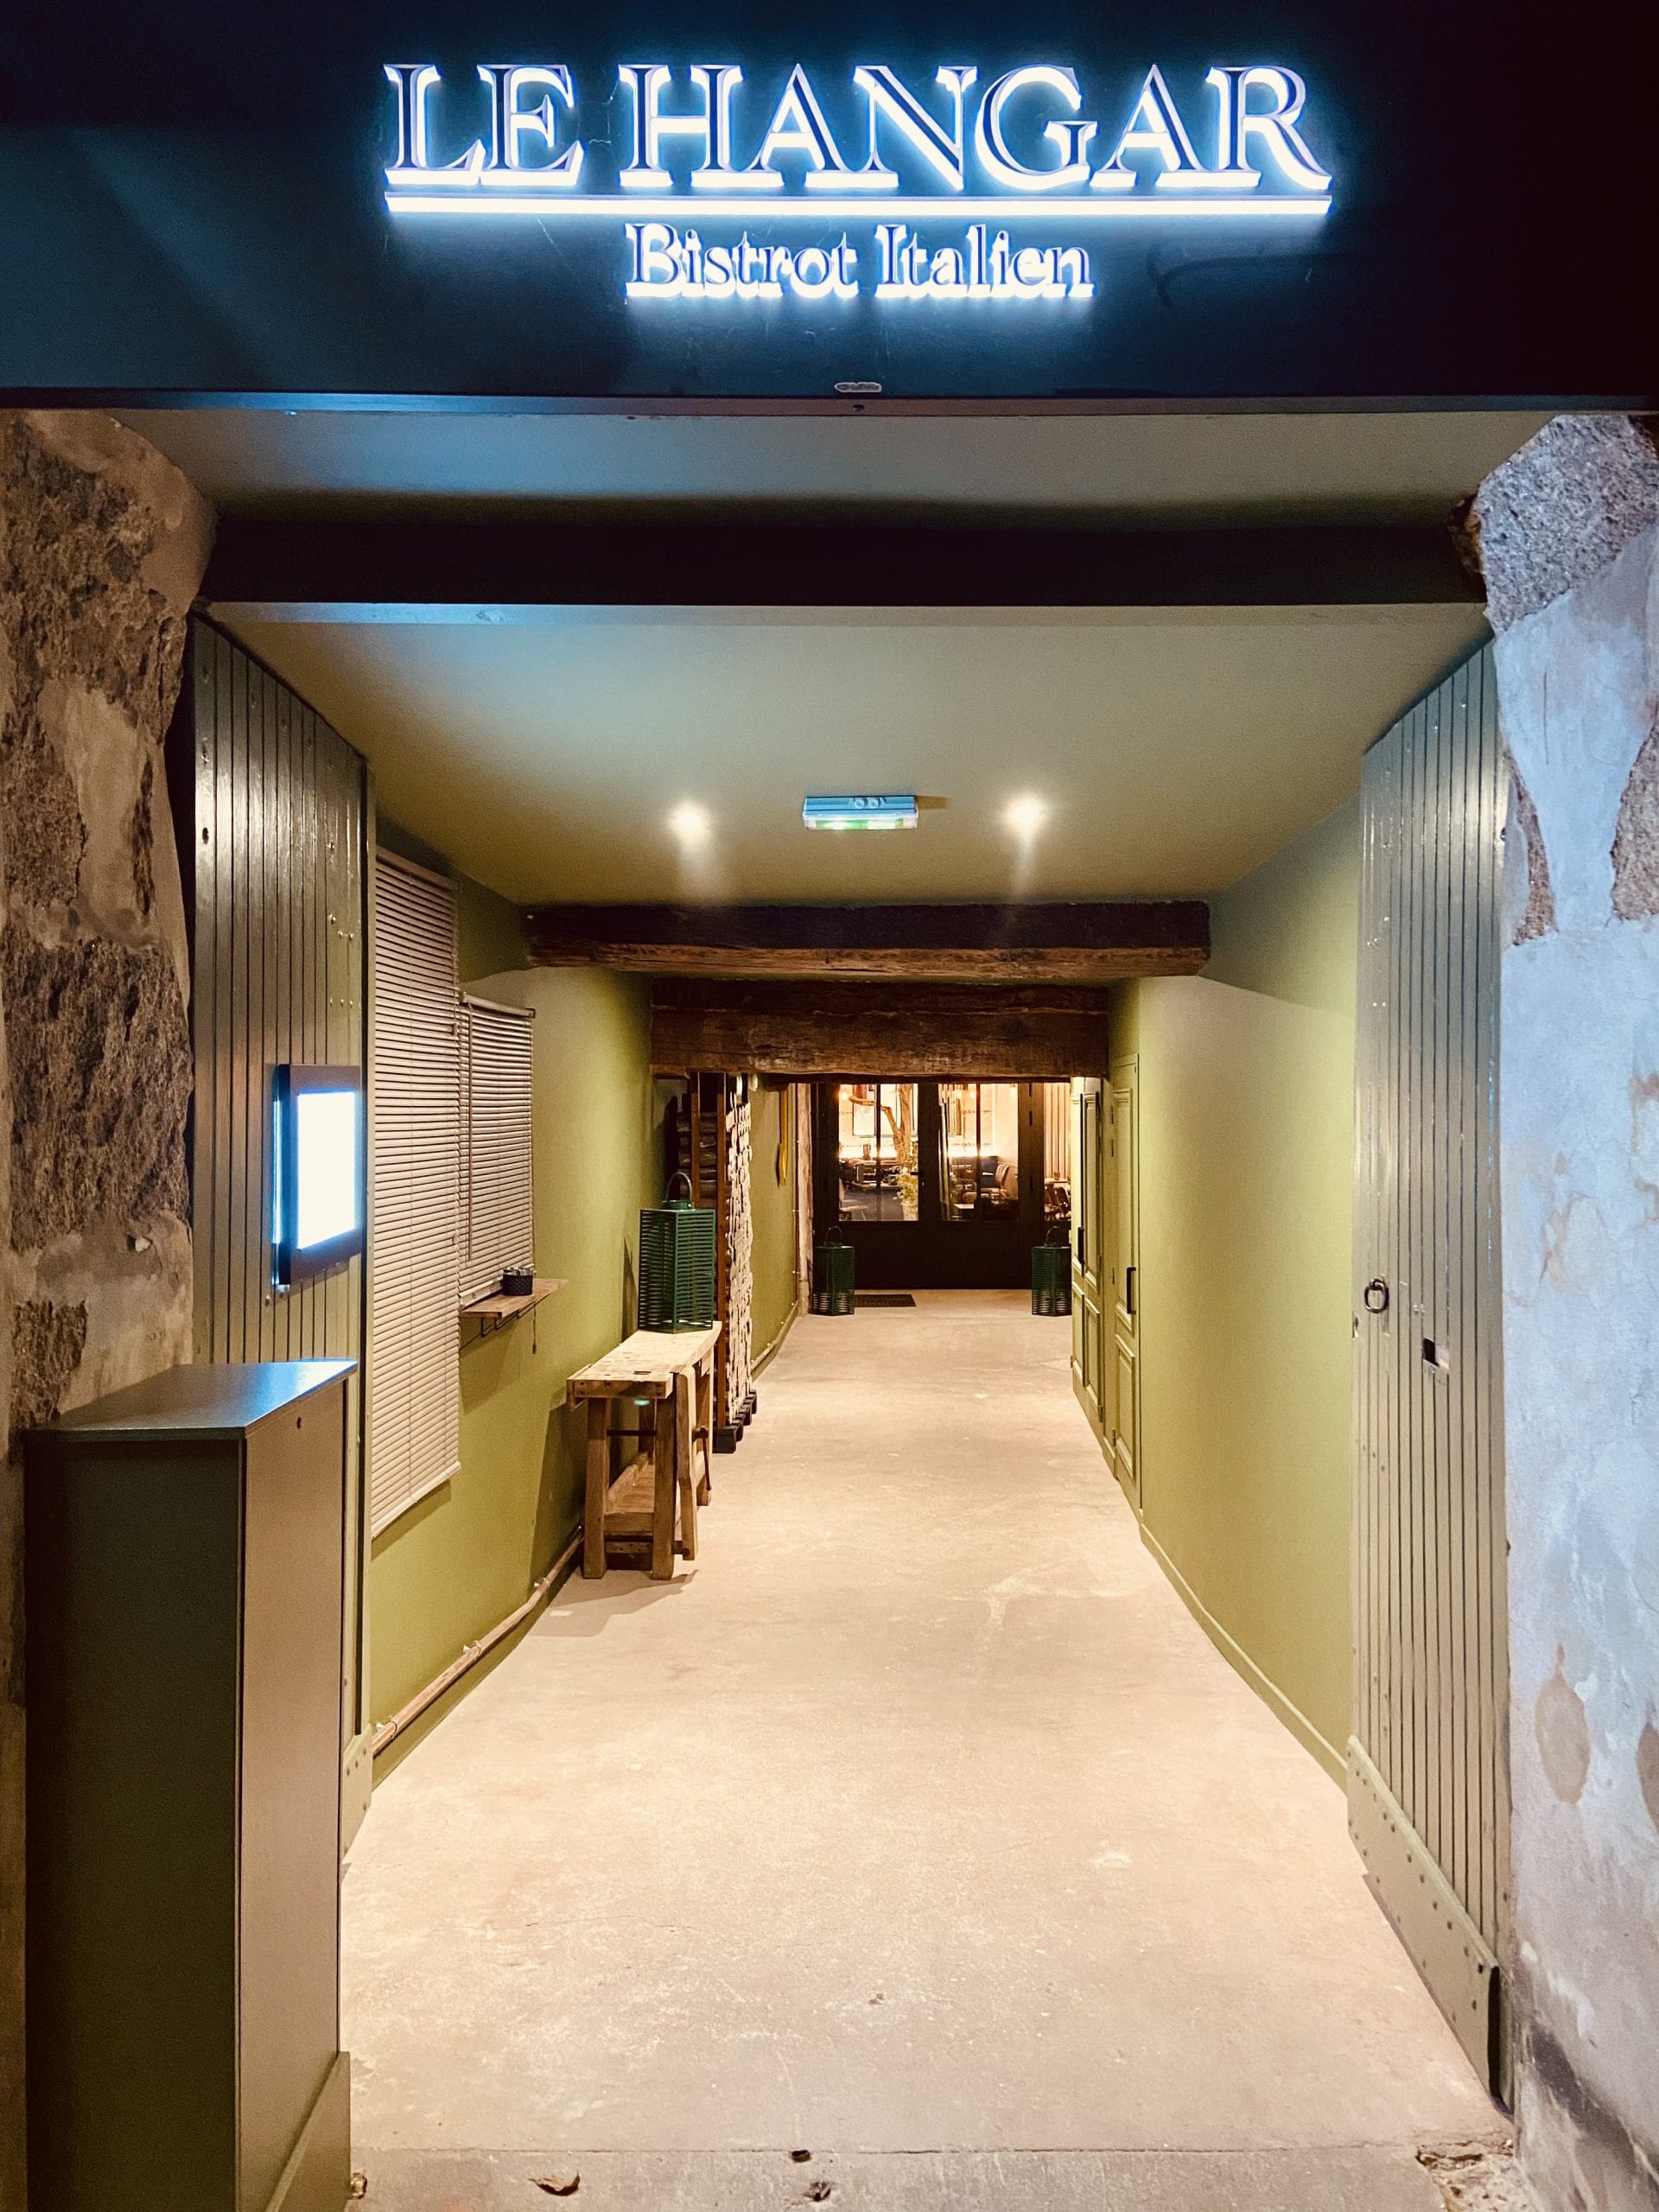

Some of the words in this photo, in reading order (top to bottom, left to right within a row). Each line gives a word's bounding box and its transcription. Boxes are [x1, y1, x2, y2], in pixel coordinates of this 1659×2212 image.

[384, 63, 584, 186] LE
[617, 63, 1332, 190] HANGAR
[626, 223, 859, 299] Bistrot
[875, 223, 1094, 299] Italien
